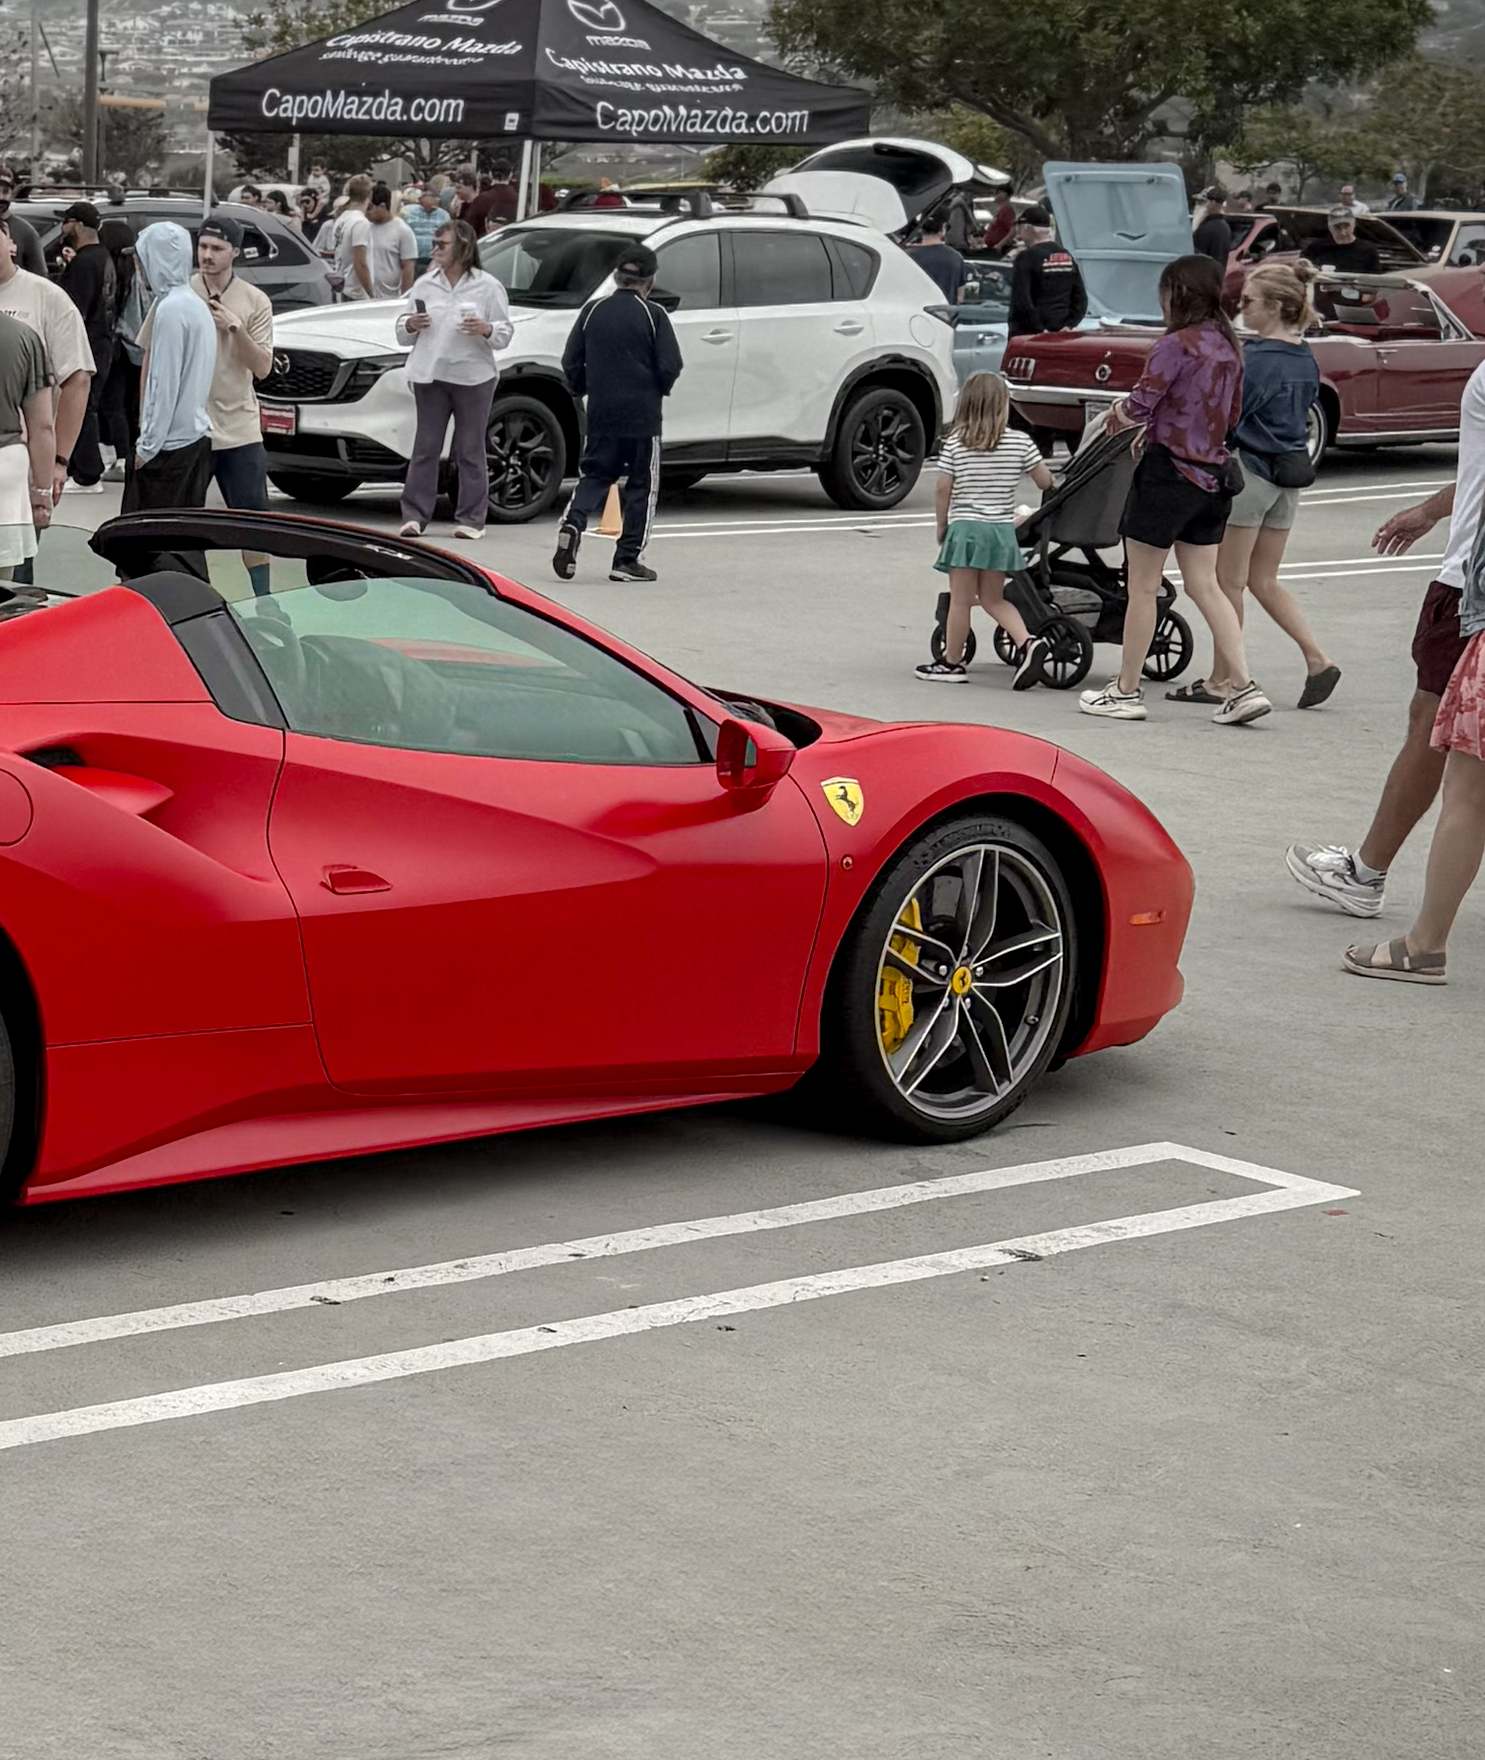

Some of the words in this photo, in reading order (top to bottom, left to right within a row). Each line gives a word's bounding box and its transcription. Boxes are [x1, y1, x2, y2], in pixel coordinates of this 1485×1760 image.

[325, 29, 442, 50] Capistrano
[441, 36, 523, 55] Mazda
[544, 47, 663, 78] Capistrano
[661, 62, 748, 81] Mazda
[261, 88, 465, 127] CapoMazda.com
[595, 101, 809, 137] CapoMazda.com
